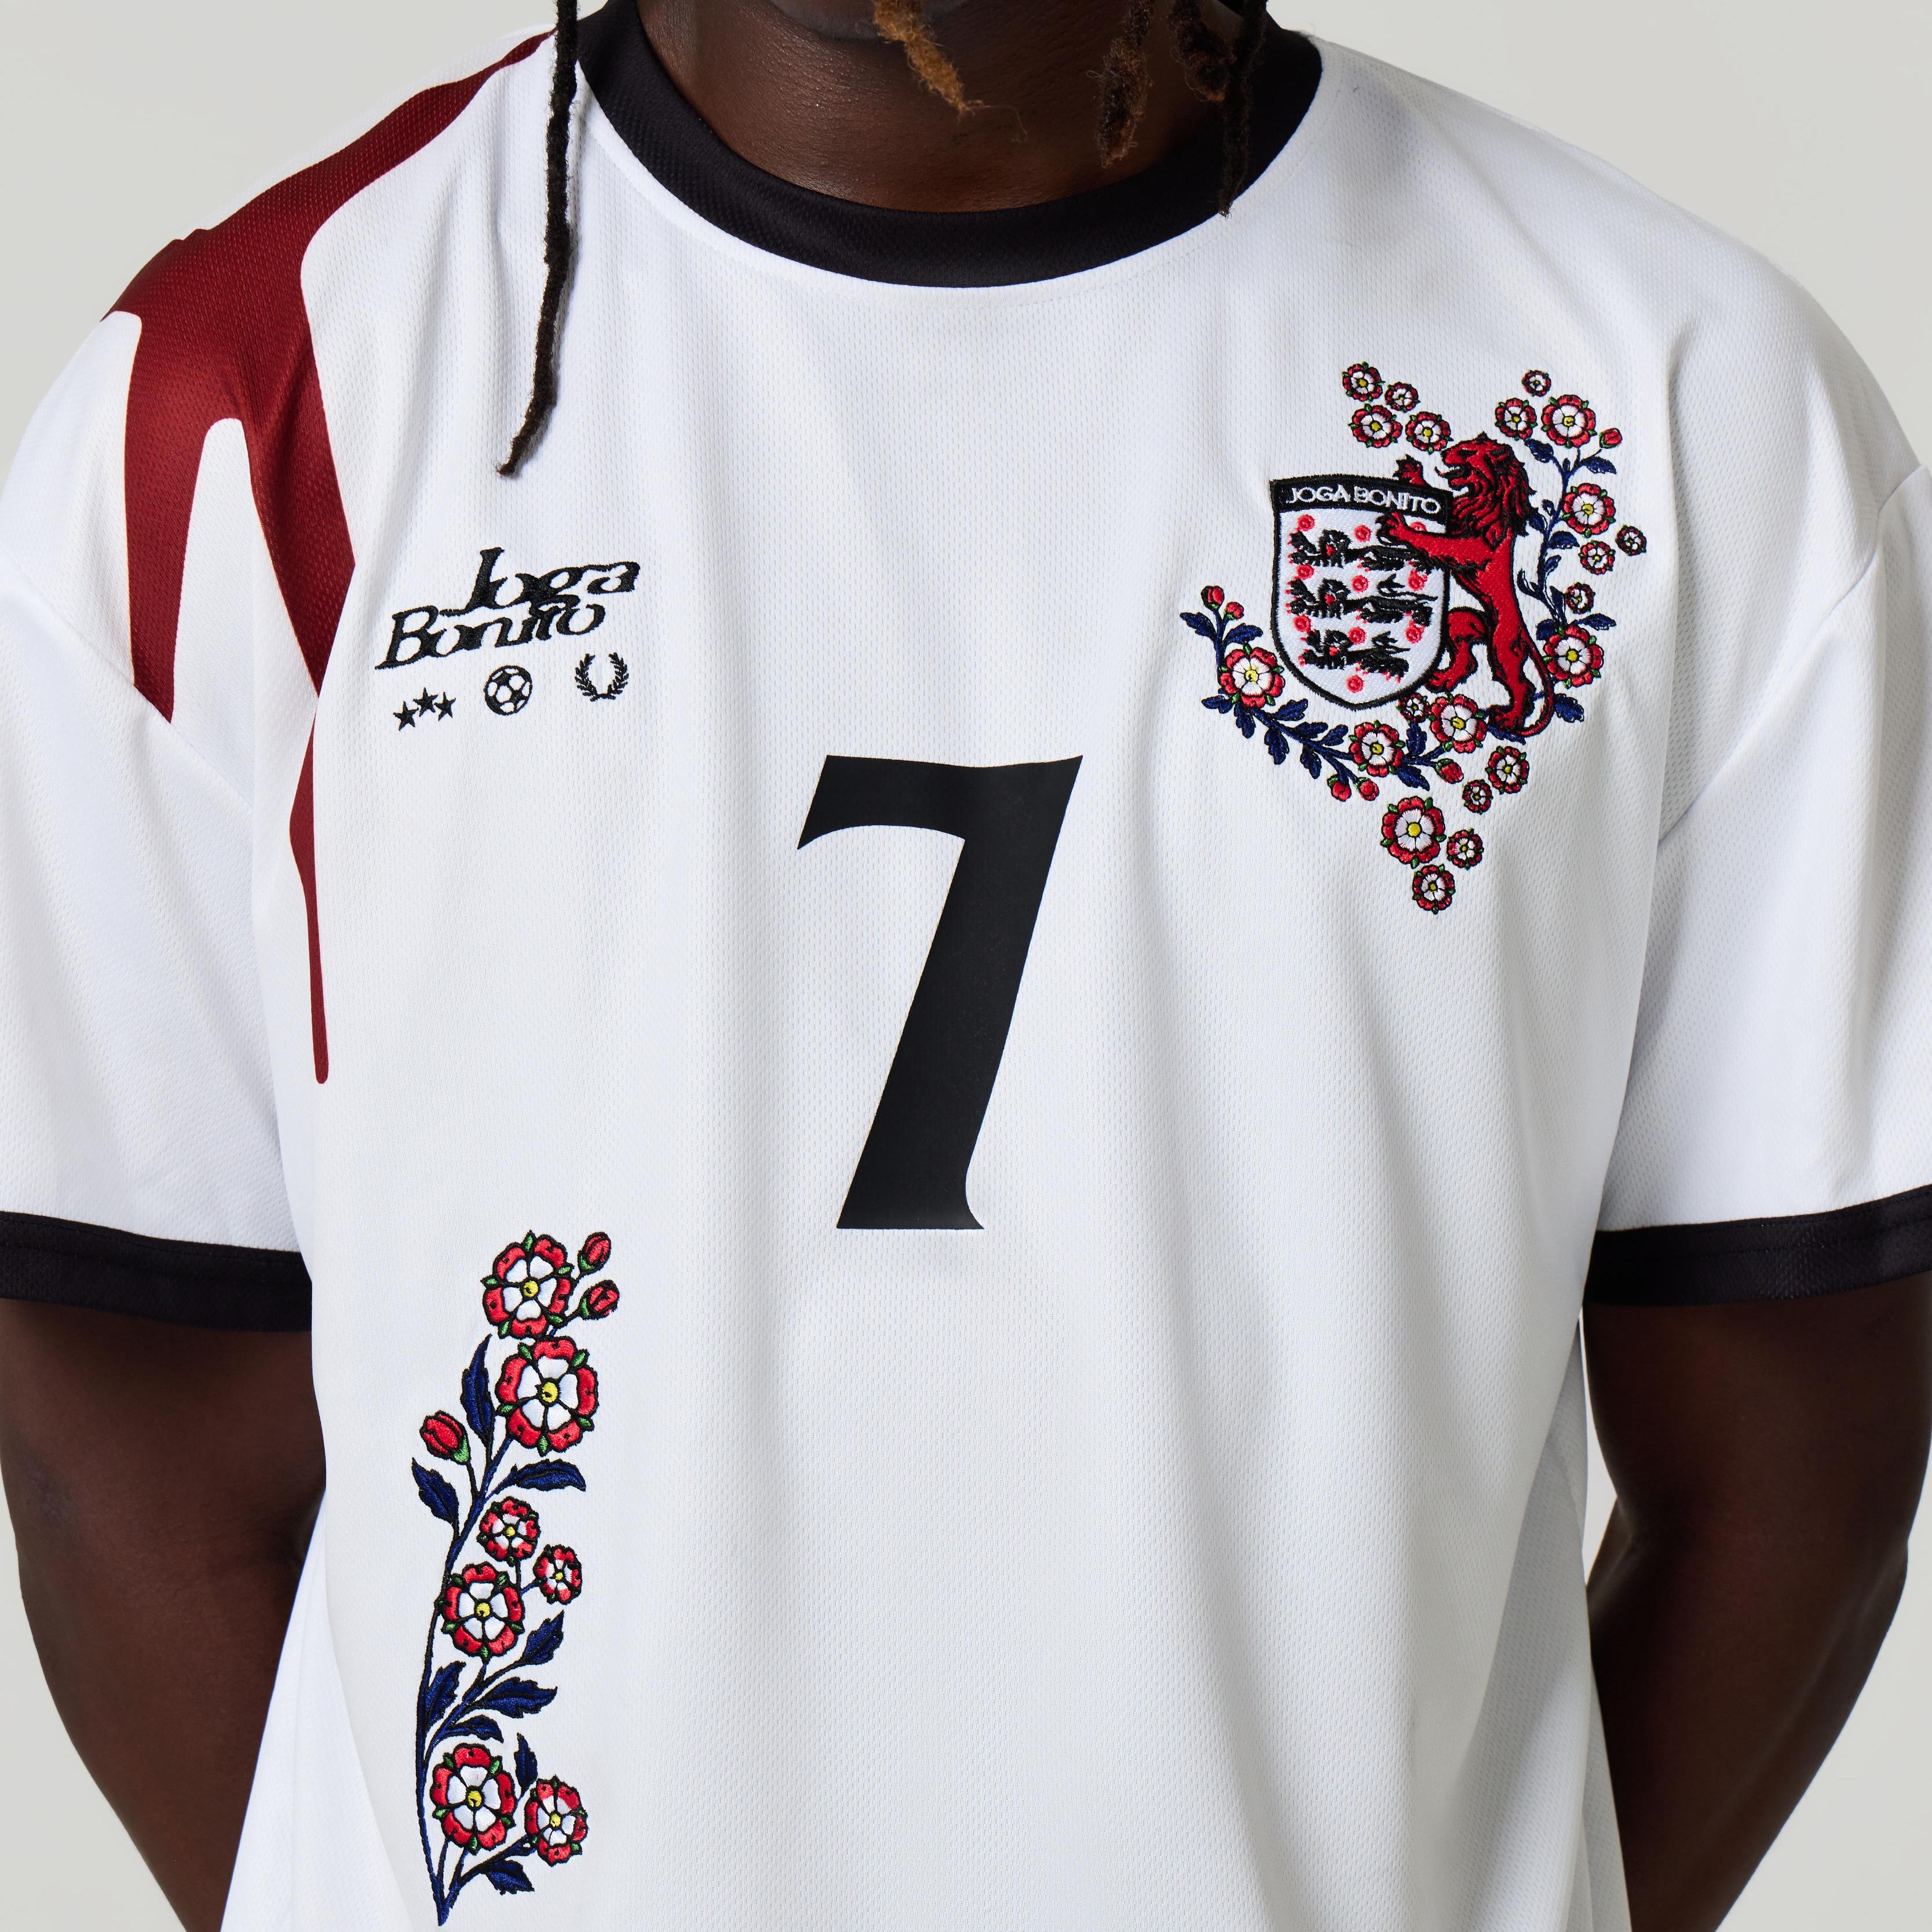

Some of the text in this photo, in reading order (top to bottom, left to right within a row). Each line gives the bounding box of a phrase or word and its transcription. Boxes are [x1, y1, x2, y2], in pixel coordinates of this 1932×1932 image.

[1286, 484, 1442, 514] JOGA BONITO
[439, 547, 641, 617] Joga
[375, 604, 606, 670] Bonito
[797, 755, 1083, 1229] 7
